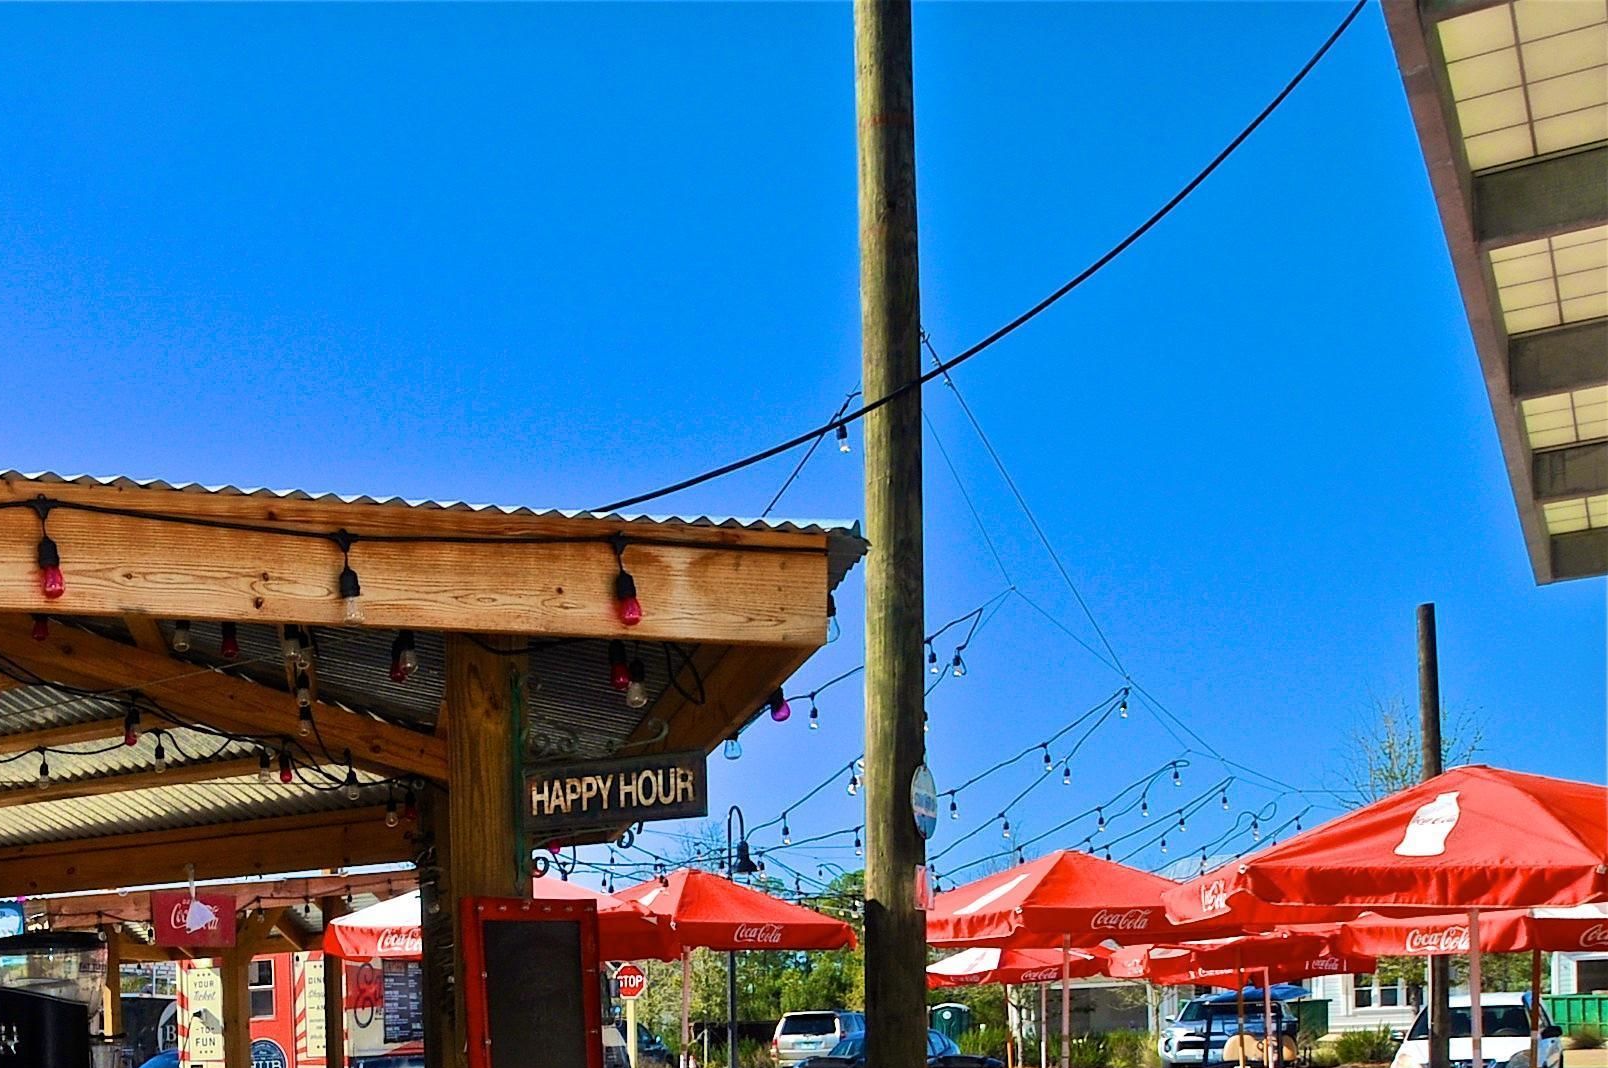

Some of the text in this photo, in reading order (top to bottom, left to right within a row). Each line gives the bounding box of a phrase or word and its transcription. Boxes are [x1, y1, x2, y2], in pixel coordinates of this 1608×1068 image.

[531, 767, 695, 816] HAPPY HOUR
[1091, 909, 1152, 930] Coca-Cola
[734, 923, 784, 943] Coca-Cola
[194, 980, 214, 988] YOUR
[617, 975, 643, 988] STOP
[195, 1037, 216, 1047] FUN
